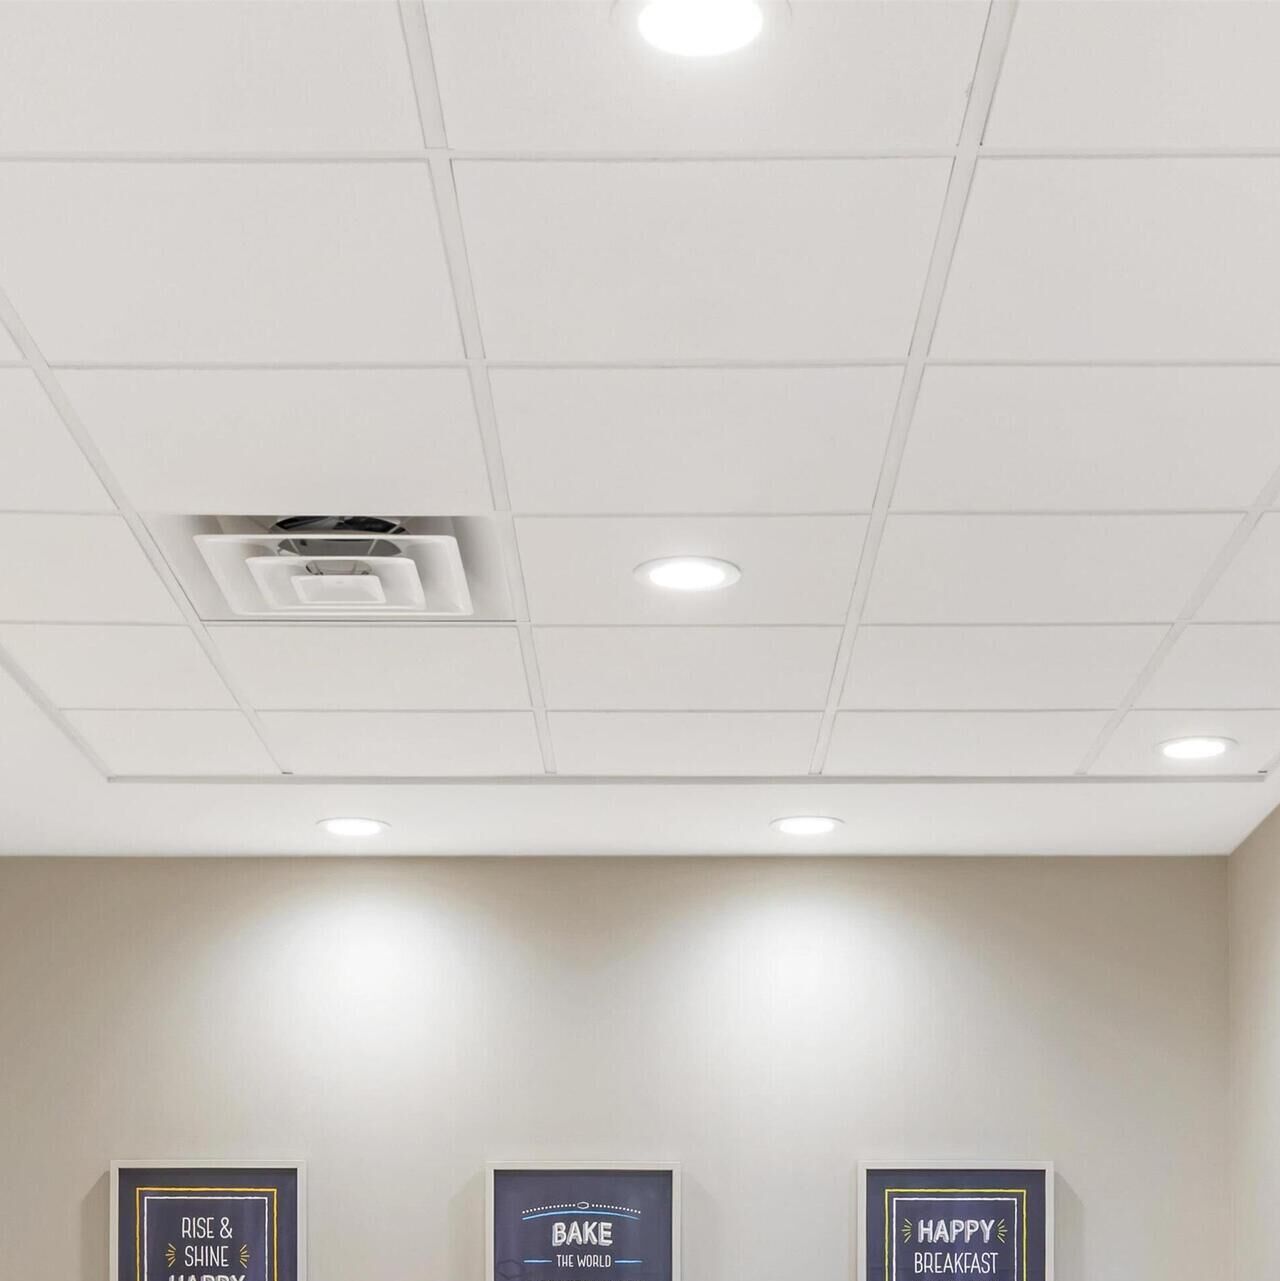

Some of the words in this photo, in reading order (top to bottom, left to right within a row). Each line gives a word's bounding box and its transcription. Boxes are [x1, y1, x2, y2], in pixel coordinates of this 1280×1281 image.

[181, 1217, 214, 1239] RISE
[219, 1217, 233, 1239] &
[552, 1221, 613, 1247] BAKE
[917, 1219, 996, 1244] HAPPY
[184, 1245, 229, 1267] SHINE
[556, 1254, 574, 1268] THE
[576, 1254, 612, 1268] WORLD
[914, 1252, 999, 1274] BREAKFAST
